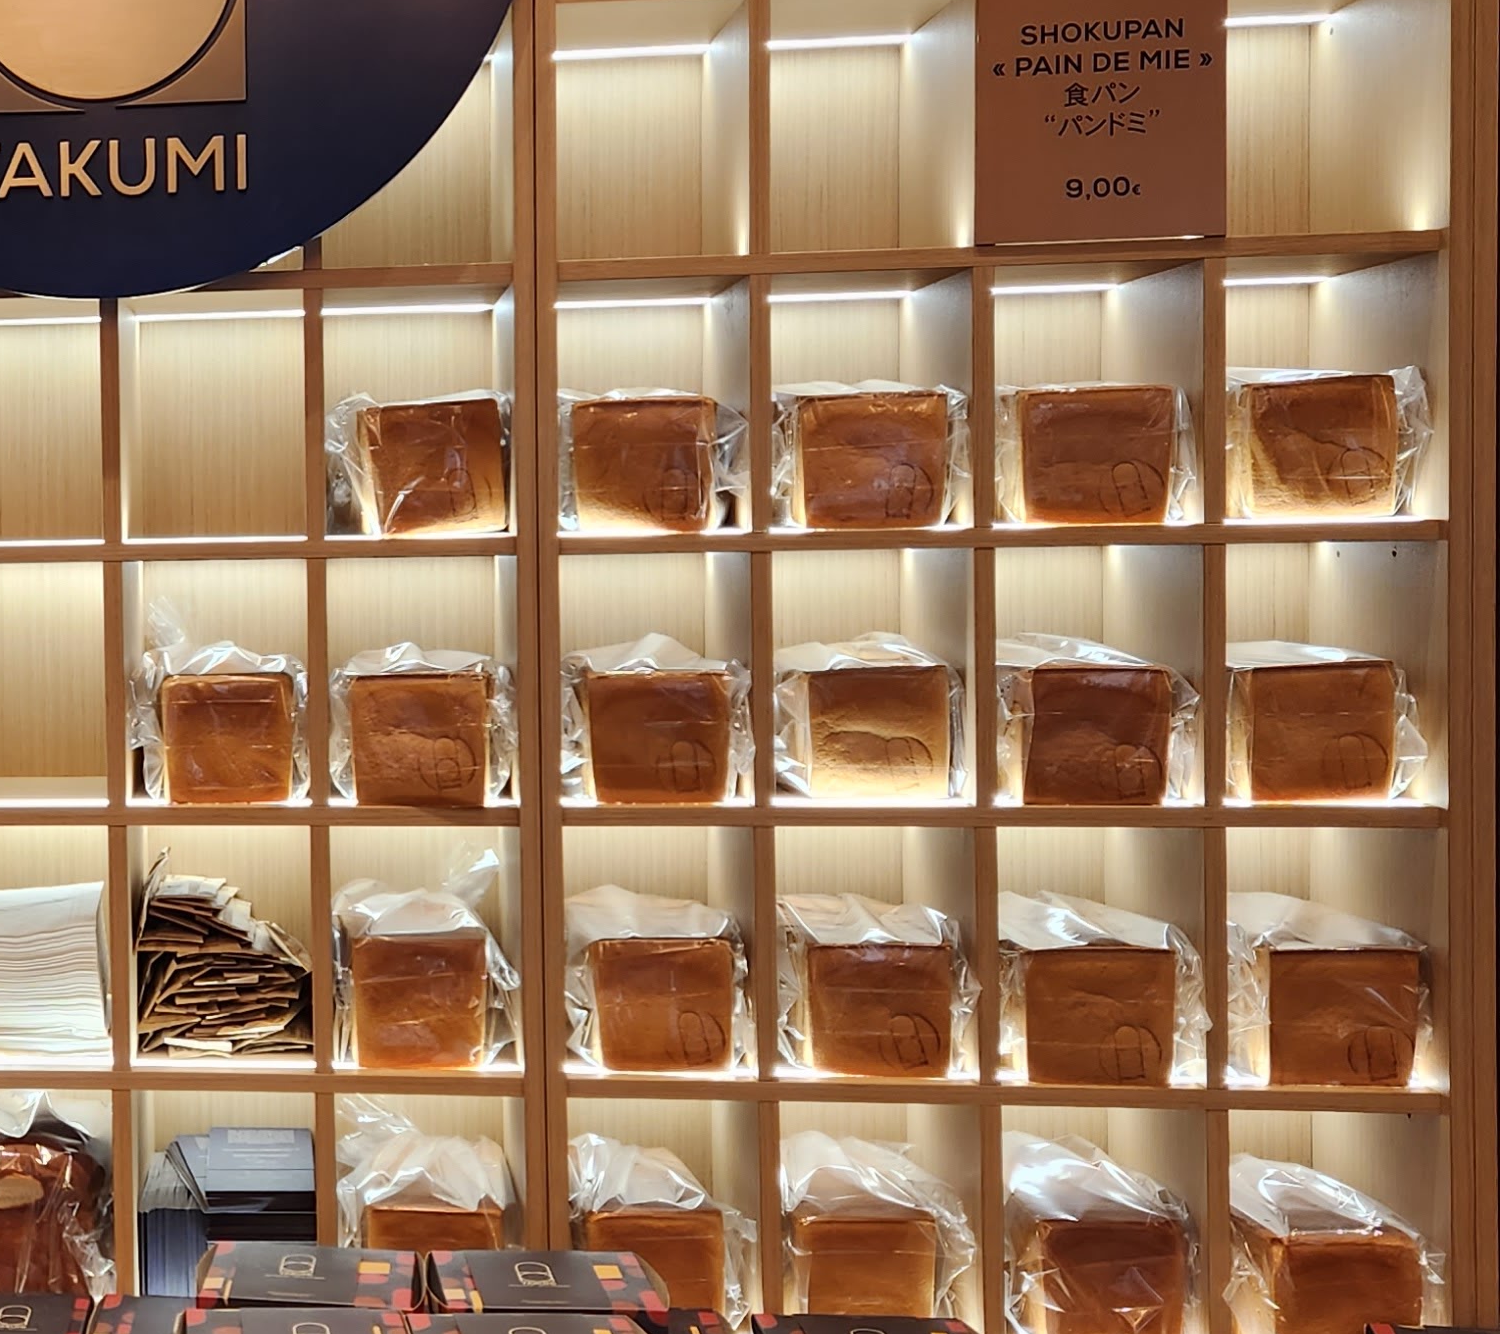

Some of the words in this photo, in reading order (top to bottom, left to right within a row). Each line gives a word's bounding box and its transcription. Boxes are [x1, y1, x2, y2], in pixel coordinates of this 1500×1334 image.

[1020, 17, 1184, 46] SHOKUPAN
[1014, 53, 1082, 77] PAIN
[1093, 51, 1130, 73] DE
[1139, 49, 1191, 70] MIE
[1063, 82, 1141, 107] 食パン
[1065, 176, 1141, 200] 9,00€
